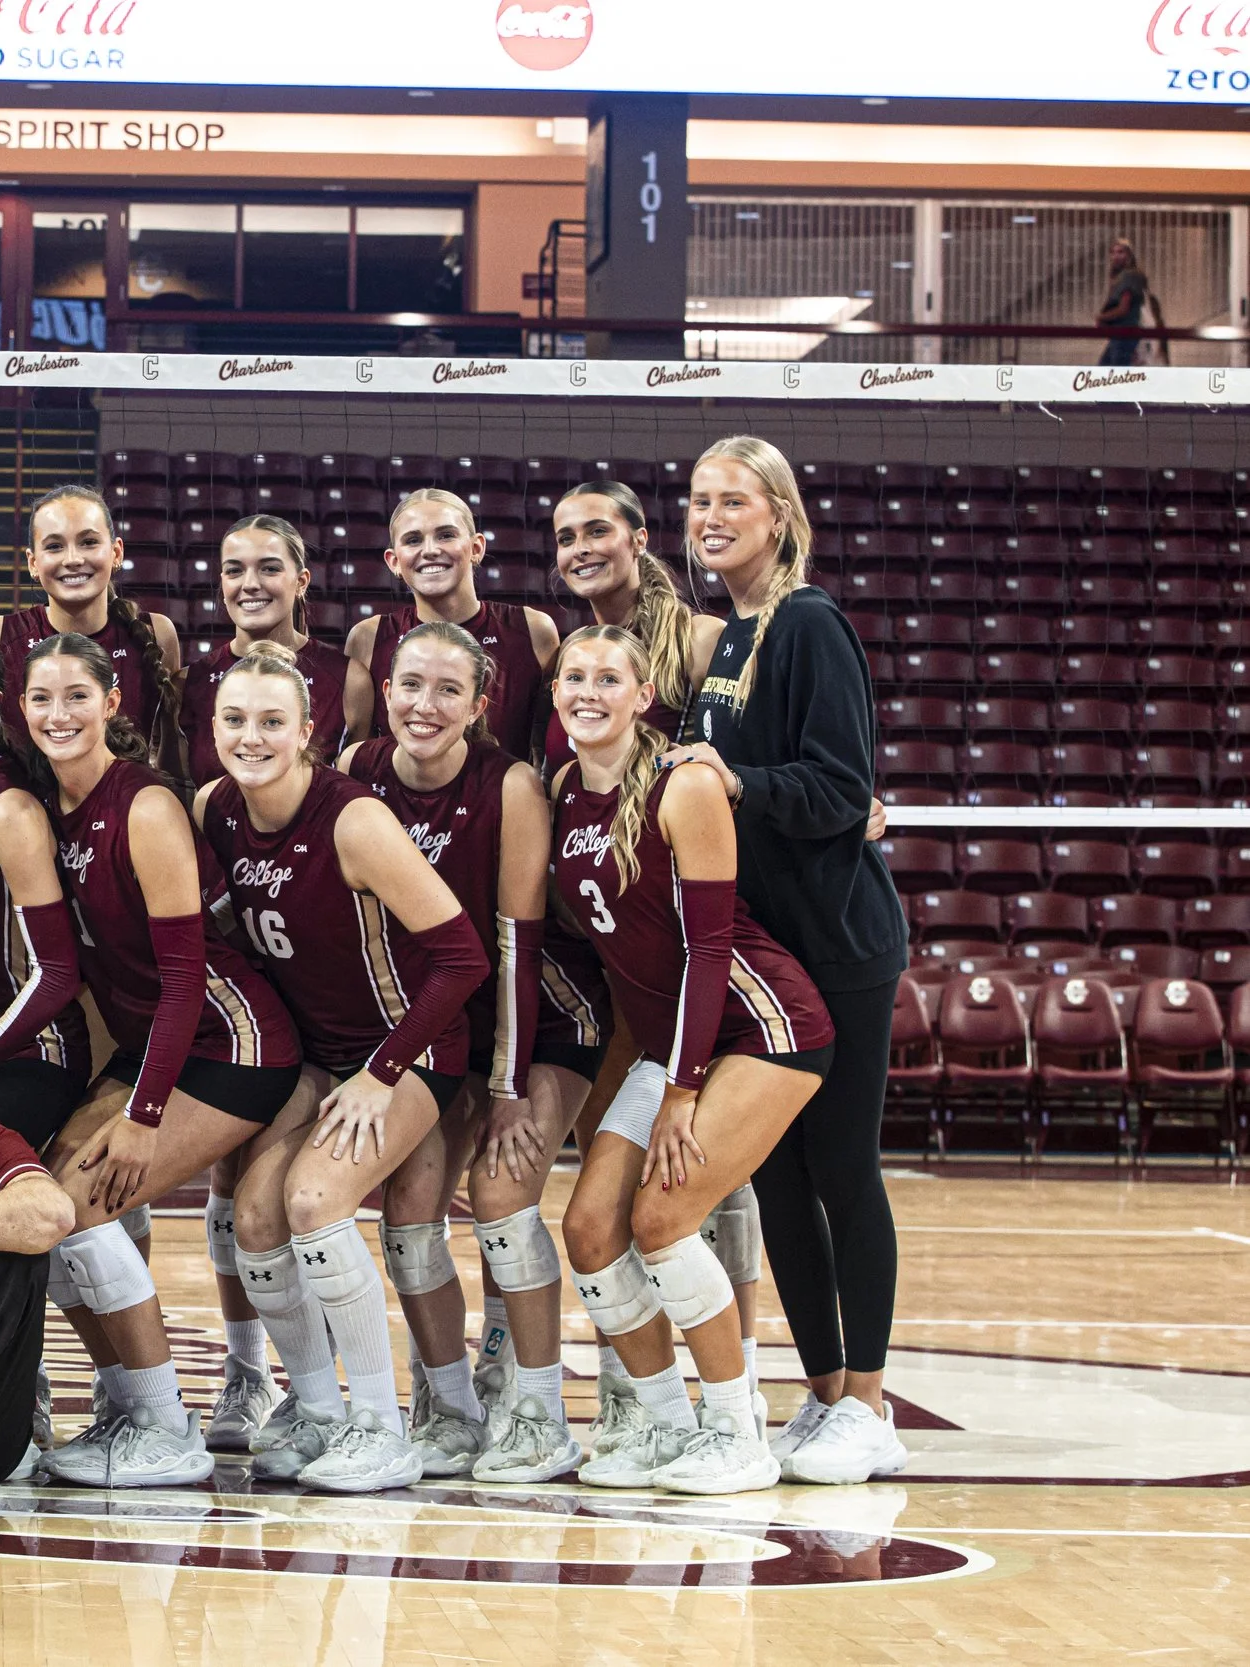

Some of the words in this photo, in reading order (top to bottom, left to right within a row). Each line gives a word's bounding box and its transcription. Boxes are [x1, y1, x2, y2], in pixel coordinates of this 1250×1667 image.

[17, 47, 125, 70] SUGAR
[1167, 68, 1250, 91] zero
[123, 122, 225, 151] SHOP
[640, 151, 662, 243] 101
[5, 354, 80, 377] Charleston
[219, 357, 293, 381] Charleston
[432, 361, 507, 384] Charleston
[647, 364, 721, 387] Charleston
[860, 367, 934, 390] Charleston
[1073, 369, 1146, 392] Charleston
[579, 879, 617, 934] 3
[241, 907, 295, 959] 16
